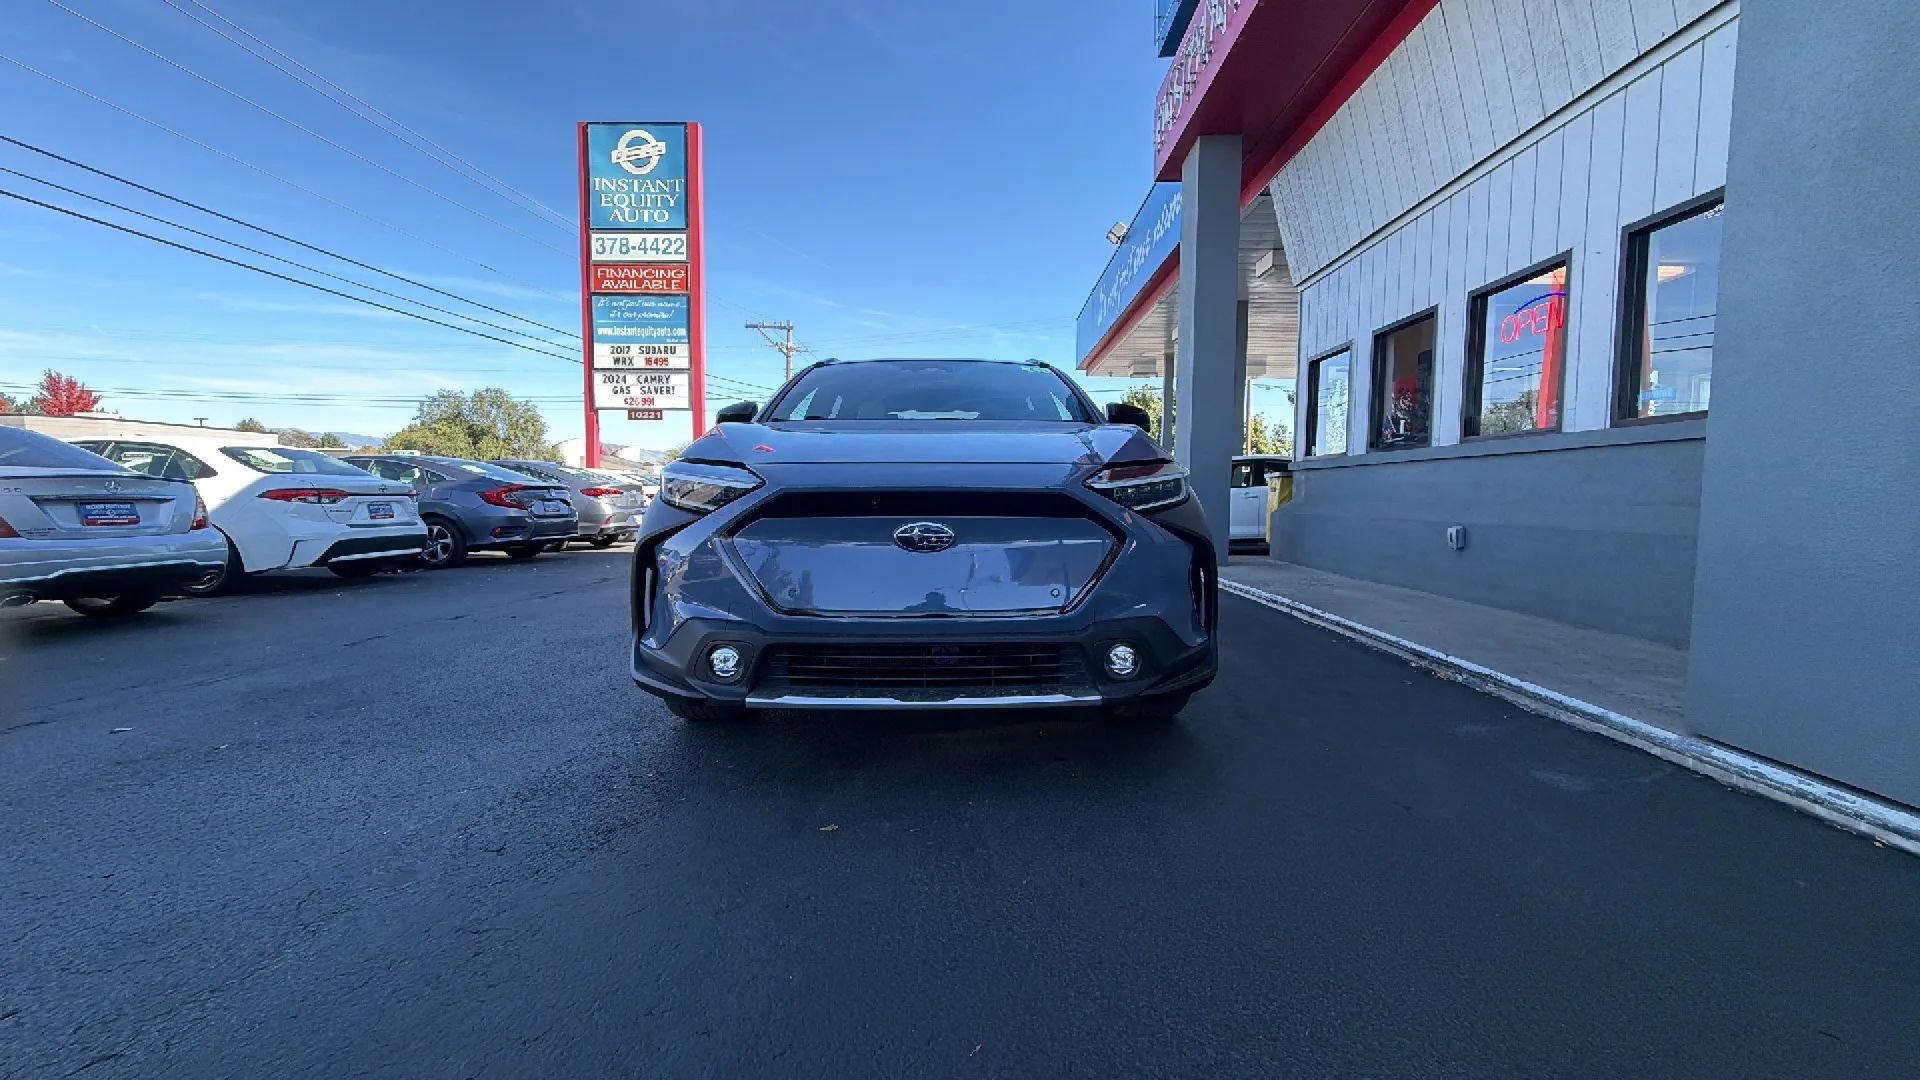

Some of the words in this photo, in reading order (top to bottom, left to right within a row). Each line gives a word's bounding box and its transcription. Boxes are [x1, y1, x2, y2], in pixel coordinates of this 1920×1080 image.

[594, 178, 684, 192] INSTANT
[601, 194, 678, 208] EQUITY
[610, 208, 668, 222] AUTO
[595, 237, 685, 255] 378-4422
[597, 267, 686, 279] FINANCING
[601, 279, 682, 290] AVAILABLE
[1501, 297, 1565, 344] OPEN
[610, 346, 631, 355] 2017
[638, 346, 677, 355] SUBARU
[613, 357, 634, 366] WRX
[602, 374, 627, 384] 2024
[637, 374, 671, 384] CAMRY
[612, 386, 631, 395] GAS
[640, 386, 676, 395] SAVER!
